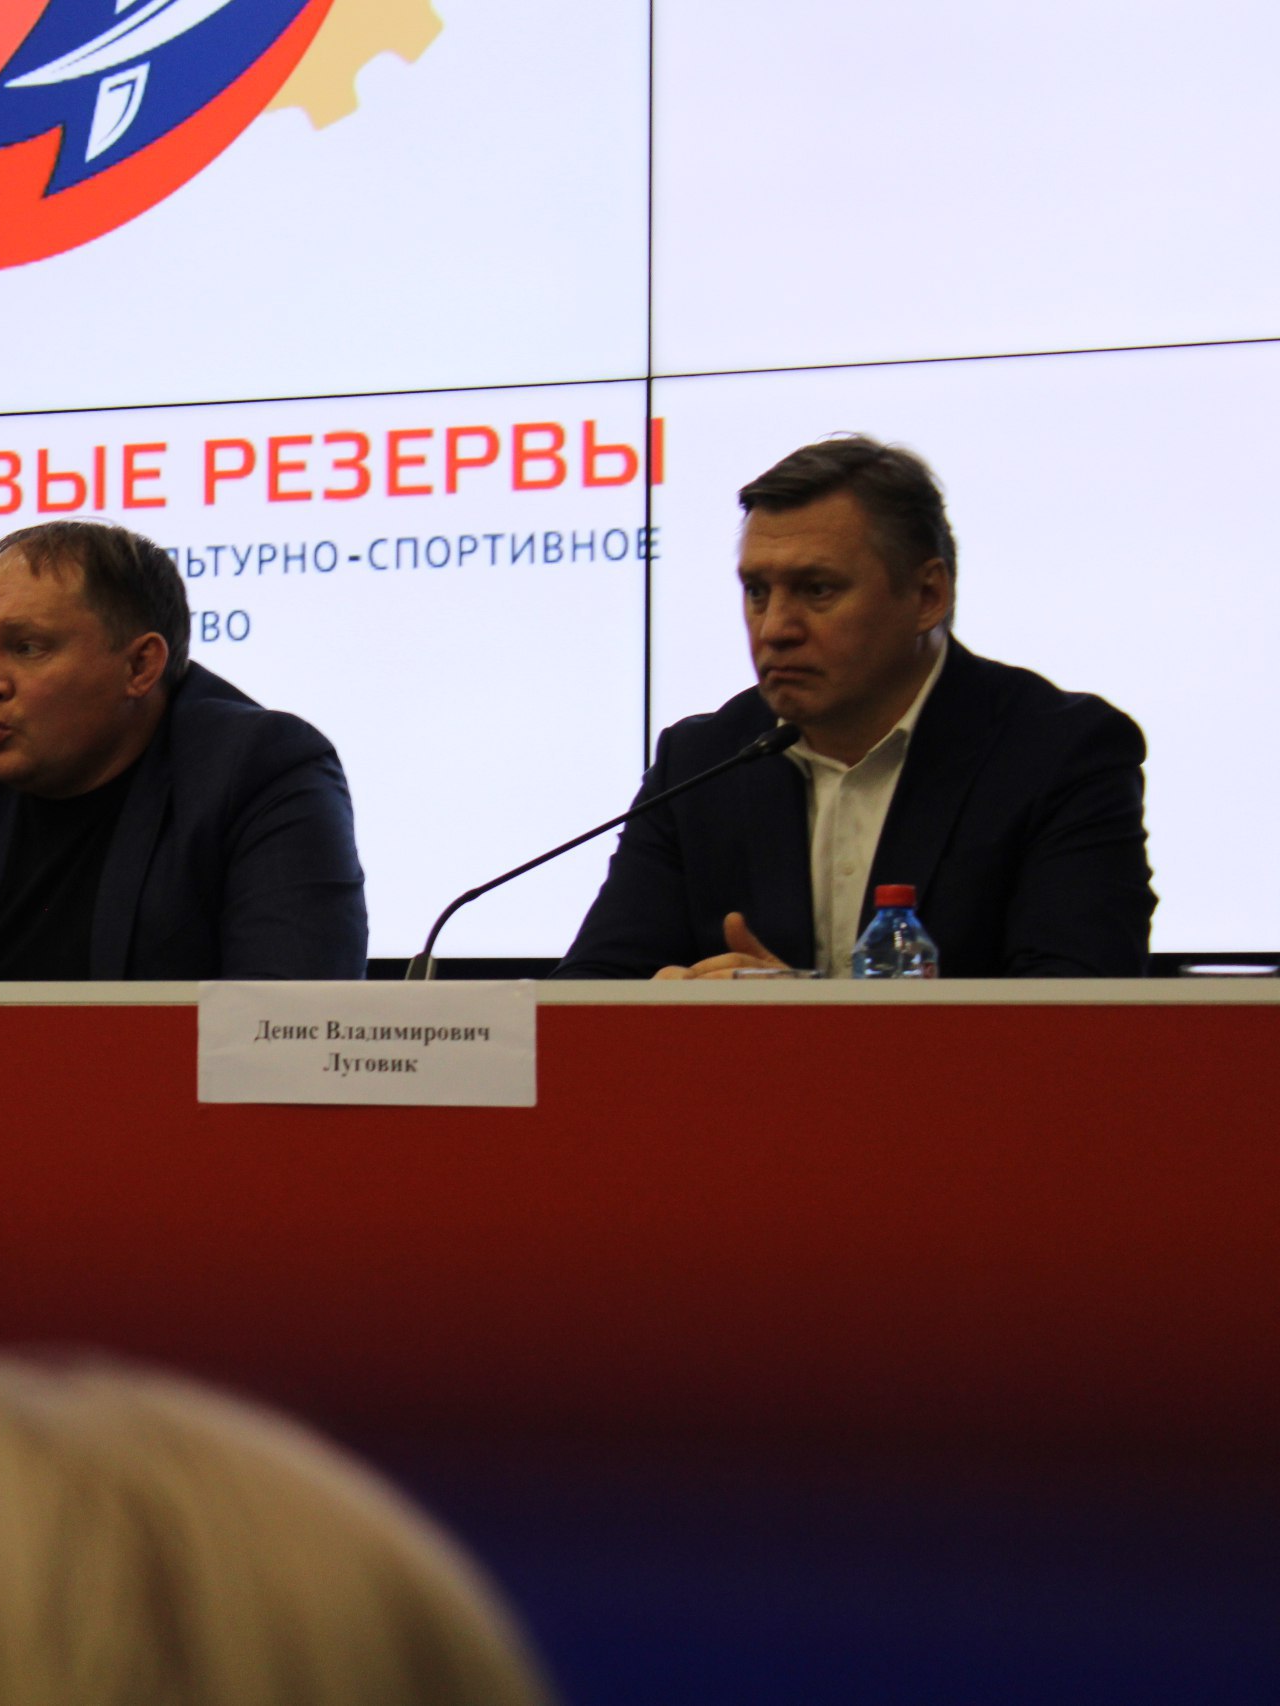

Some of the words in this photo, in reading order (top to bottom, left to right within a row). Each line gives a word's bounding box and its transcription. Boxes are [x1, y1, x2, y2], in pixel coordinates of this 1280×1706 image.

[203, 416, 665, 506] РЕЗЕРВЫ
[254, 1019, 319, 1042] Денис
[326, 1020, 490, 1046] Владимирович
[323, 1052, 418, 1077] Луговик
